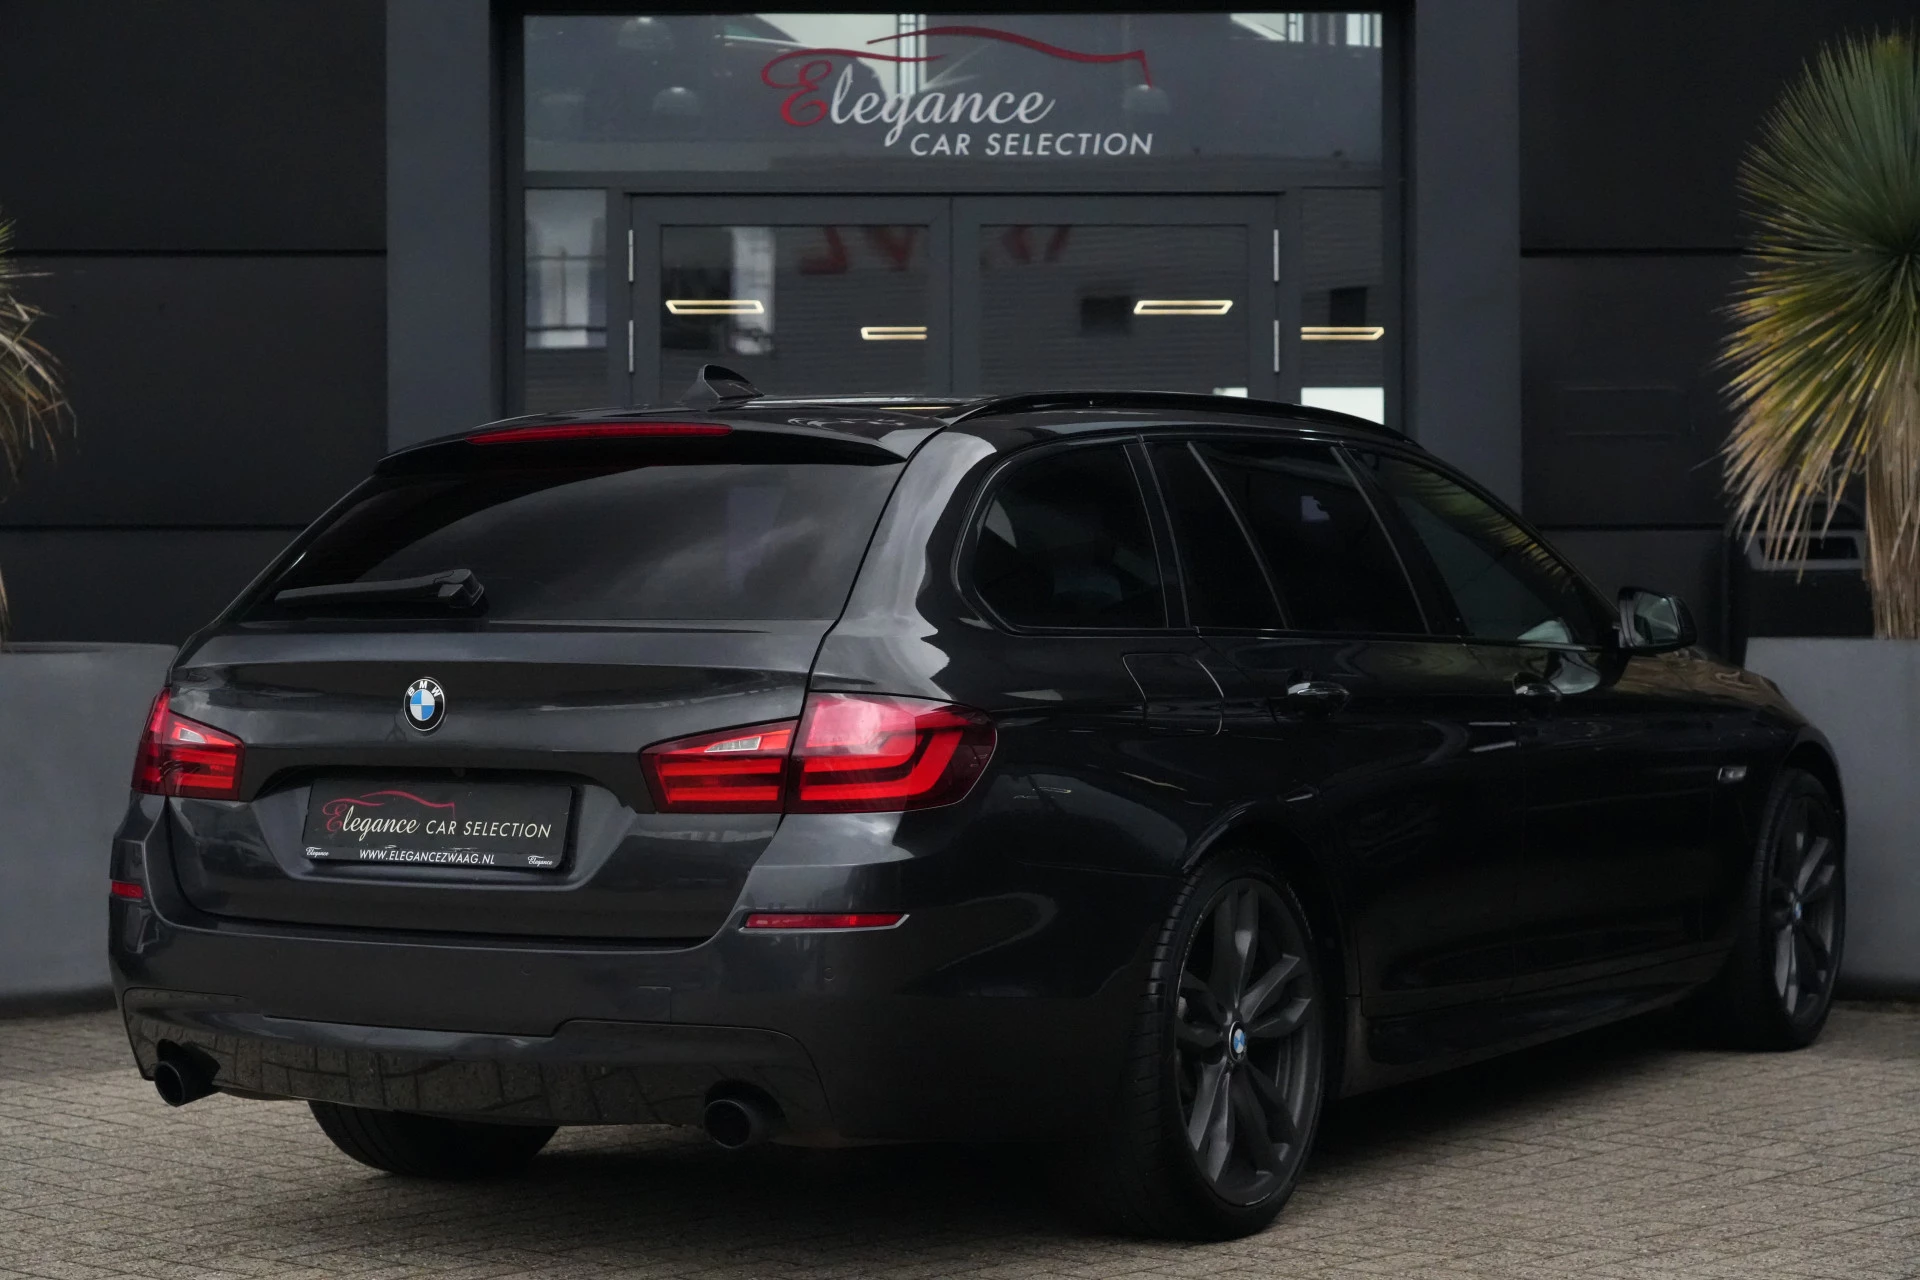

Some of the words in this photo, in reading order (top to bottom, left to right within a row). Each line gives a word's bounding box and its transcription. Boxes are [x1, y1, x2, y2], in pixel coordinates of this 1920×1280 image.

[761, 48, 1056, 147] Elegance
[910, 132, 970, 156] CAR
[985, 132, 1153, 155] SELECTION
[407, 680, 442, 697] BMW
[322, 798, 420, 841] Elegance
[425, 819, 457, 836] CAR
[463, 821, 551, 838] SELECTION
[359, 849, 495, 865] WWW.ELEGANCEZWAAG.NL
